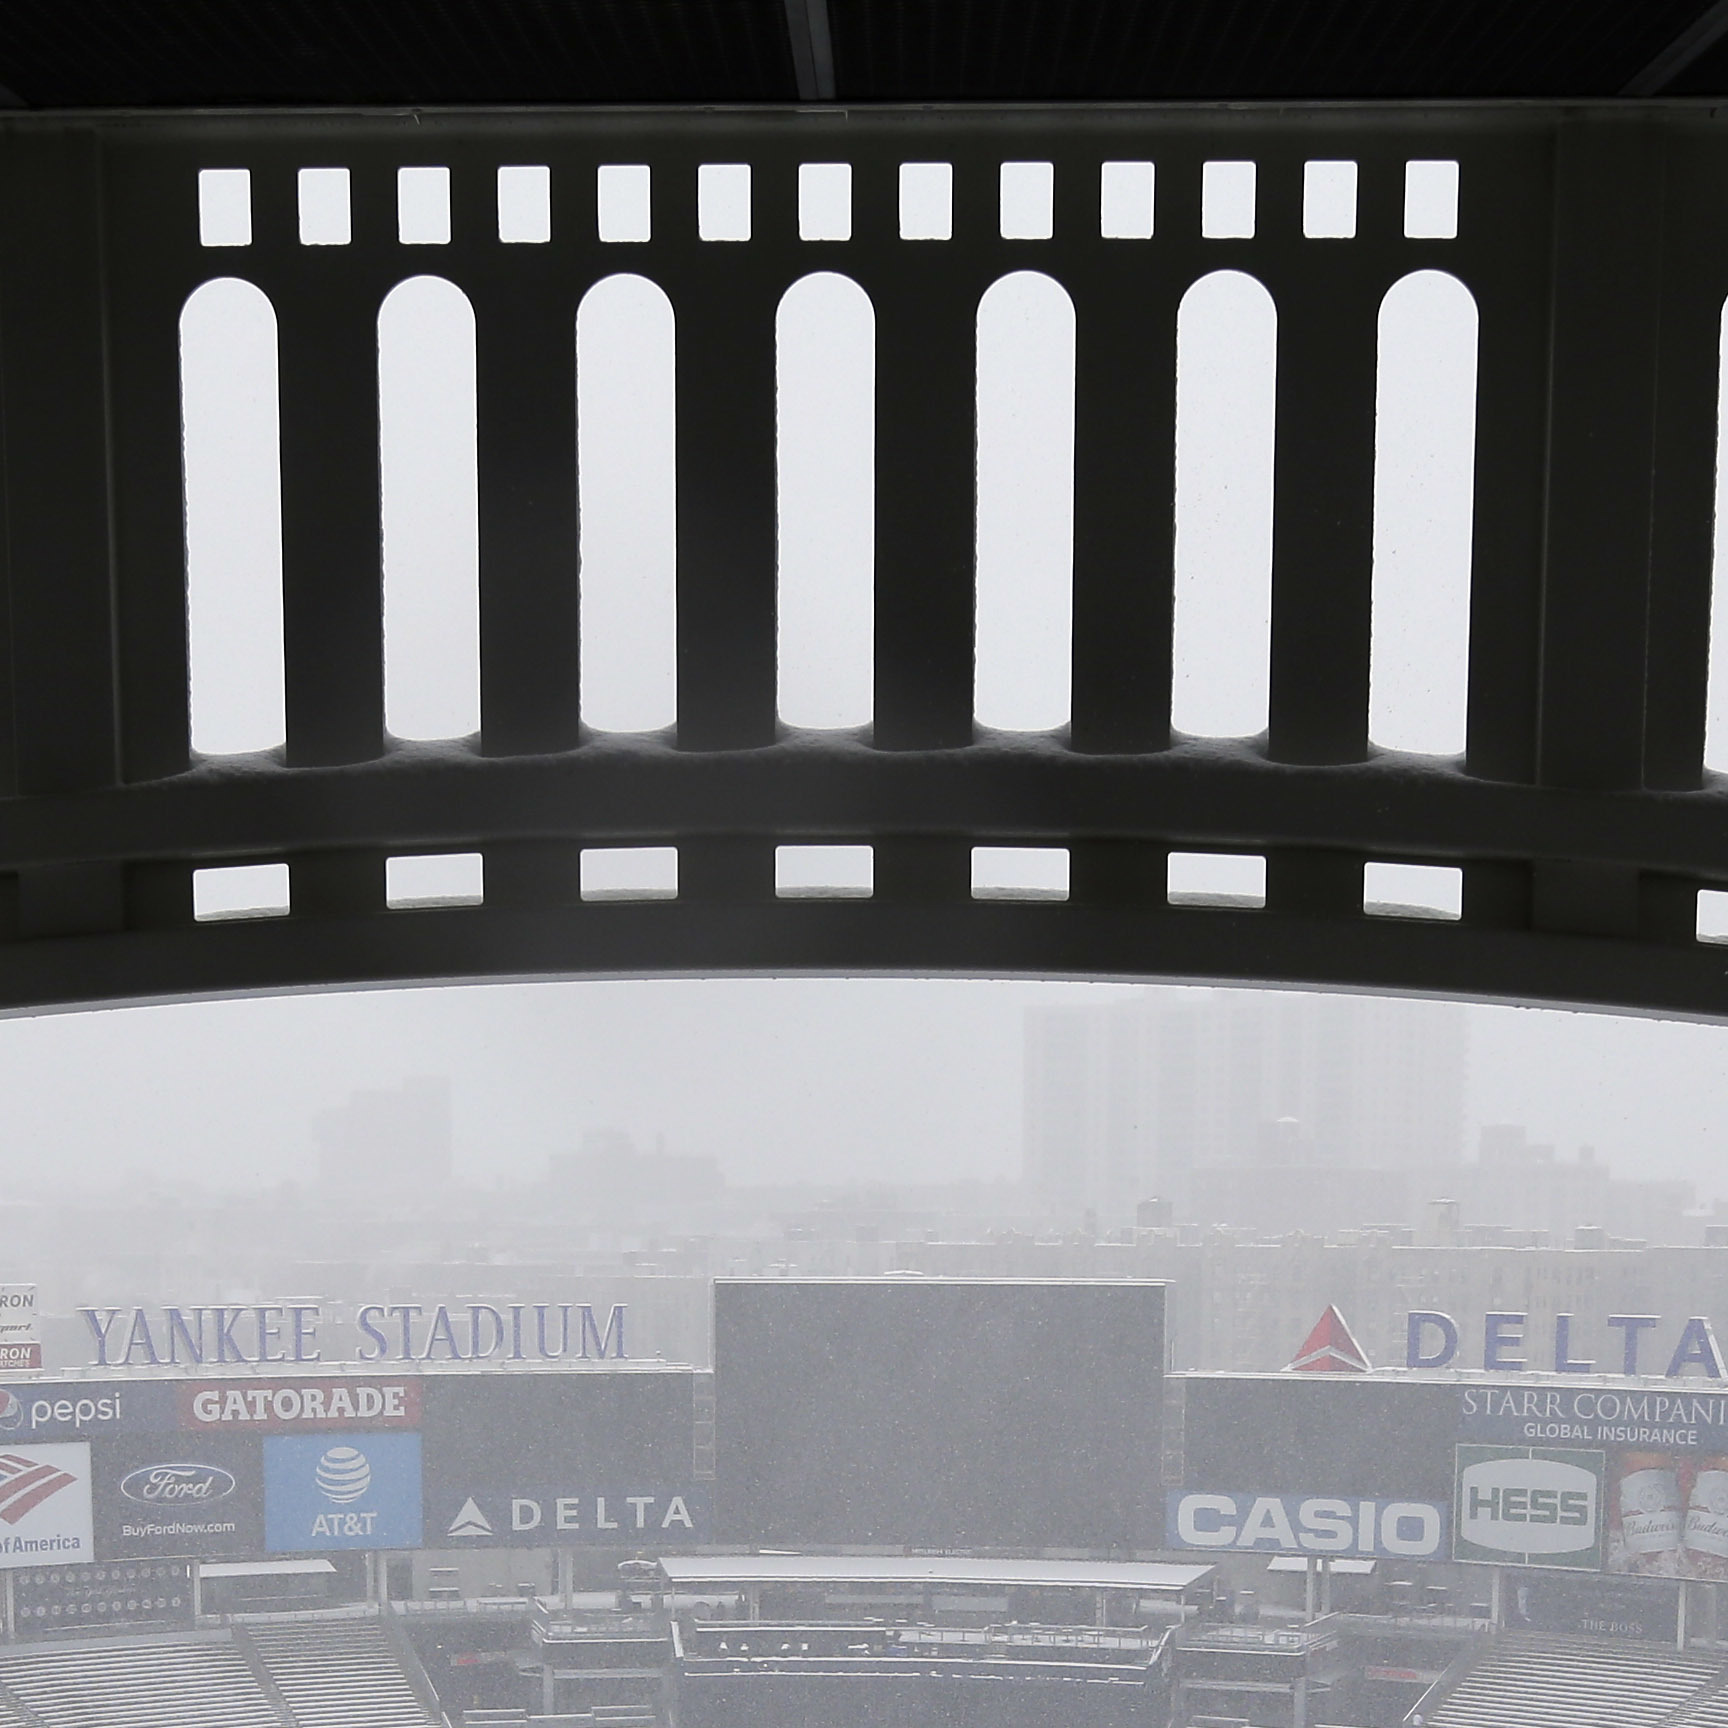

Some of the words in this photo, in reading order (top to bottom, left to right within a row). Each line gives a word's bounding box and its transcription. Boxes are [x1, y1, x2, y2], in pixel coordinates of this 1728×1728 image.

[78, 1304, 320, 1365] YANKEE
[356, 1303, 628, 1362] STADIUM
[1406, 1311, 1728, 1378] DELTA
[31, 1393, 120, 1428] pepsi
[193, 1387, 405, 1422] GATORADE
[1463, 1390, 1565, 1417] STARR
[1523, 1422, 1592, 1440] GLOBAL
[1597, 1425, 1697, 1445] INSURANCE
[143, 1469, 211, 1498] Ford
[511, 1496, 693, 1530] DELTA
[1470, 1486, 1588, 1525] HESS
[122, 1521, 235, 1537] BuyFordNow.com
[311, 1512, 377, 1537] AT&T
[1177, 1494, 1440, 1554] CASIO
[11, 1535, 80, 1554] America
[1582, 1619, 1606, 1632] THE
[1609, 1621, 1643, 1635] BOSS
